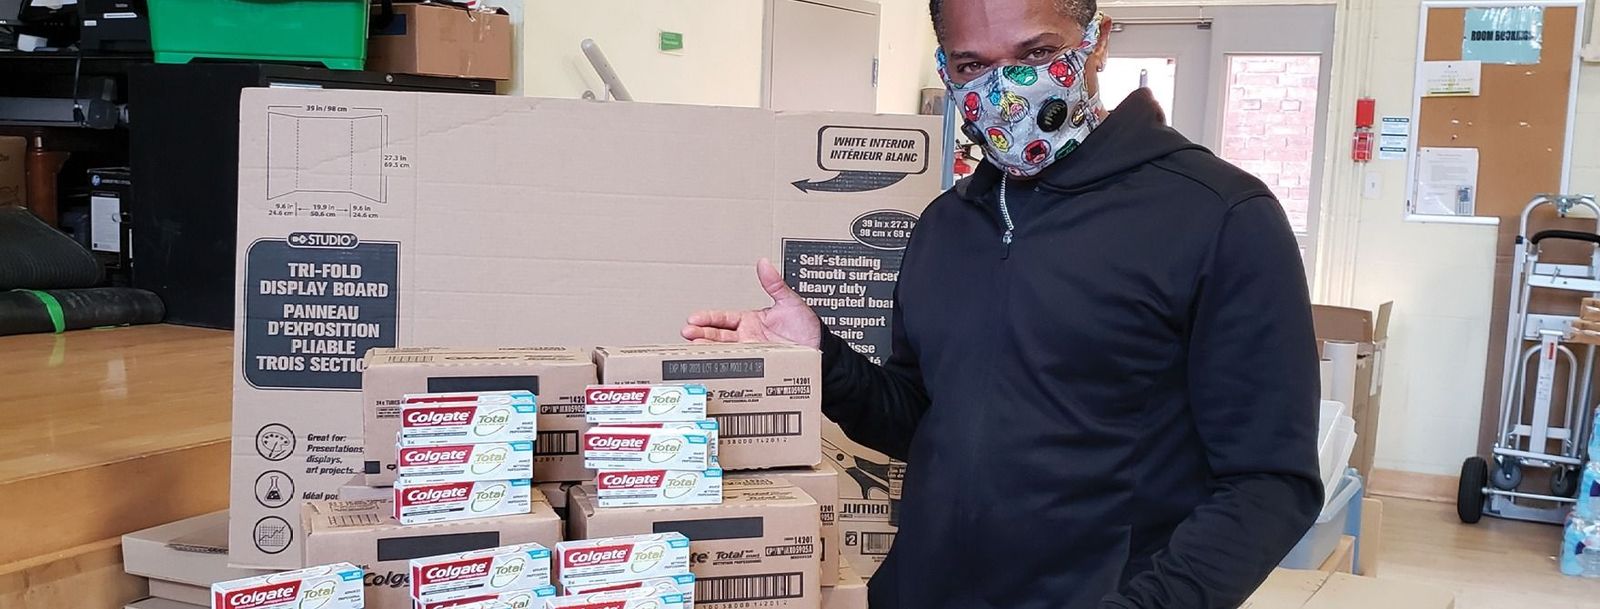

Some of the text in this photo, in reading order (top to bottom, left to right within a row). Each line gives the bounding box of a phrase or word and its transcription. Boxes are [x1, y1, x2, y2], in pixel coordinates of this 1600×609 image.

[1471, 31, 1494, 41] ROOM
[834, 136, 915, 149] WHITE INTERIOR
[830, 149, 918, 163] INTÉRIEUR BLANC
[862, 219, 872, 228] 39
[875, 220, 883, 228] in
[891, 220, 909, 229] 27.3
[859, 229, 871, 237] 98
[800, 254, 881, 270] Self-standing
[288, 263, 362, 279] TRI-FOLD
[799, 268, 846, 280] Smooth
[260, 280, 389, 298] DISPLAY BOARD
[799, 282, 867, 297] Heavy duty
[283, 304, 359, 320] PANNEAU
[839, 316, 886, 328] support
[268, 321, 380, 338] D'EXPOSITION
[291, 339, 356, 355] PLIABLE
[256, 355, 364, 372] TROIS SECTIO
[590, 390, 644, 404] Colgate
[652, 395, 681, 404] Total
[718, 389, 744, 398] Total
[408, 411, 469, 425] Colgate
[479, 414, 509, 424] Total
[307, 434, 347, 442] Great for:
[588, 436, 644, 449] Colgate
[306, 445, 364, 455] Presentations,
[651, 444, 681, 452] Total
[306, 456, 343, 465] displays,
[404, 450, 466, 464] Colgate
[475, 452, 507, 462] Total
[603, 474, 660, 487] Colgate
[667, 478, 697, 487] Total
[302, 491, 324, 500] Idéal
[407, 487, 467, 502] Colgate
[475, 490, 505, 500] Total
[839, 503, 889, 514] JUMBO
[794, 536, 813, 544] 14201
[569, 549, 627, 564] Colgate
[635, 550, 664, 561] Total
[715, 550, 744, 560] Total
[426, 562, 487, 580] Colgate
[495, 563, 524, 575] Total
[364, 571, 410, 588] Colg
[231, 586, 295, 606] Colgate
[303, 588, 335, 599] Total
